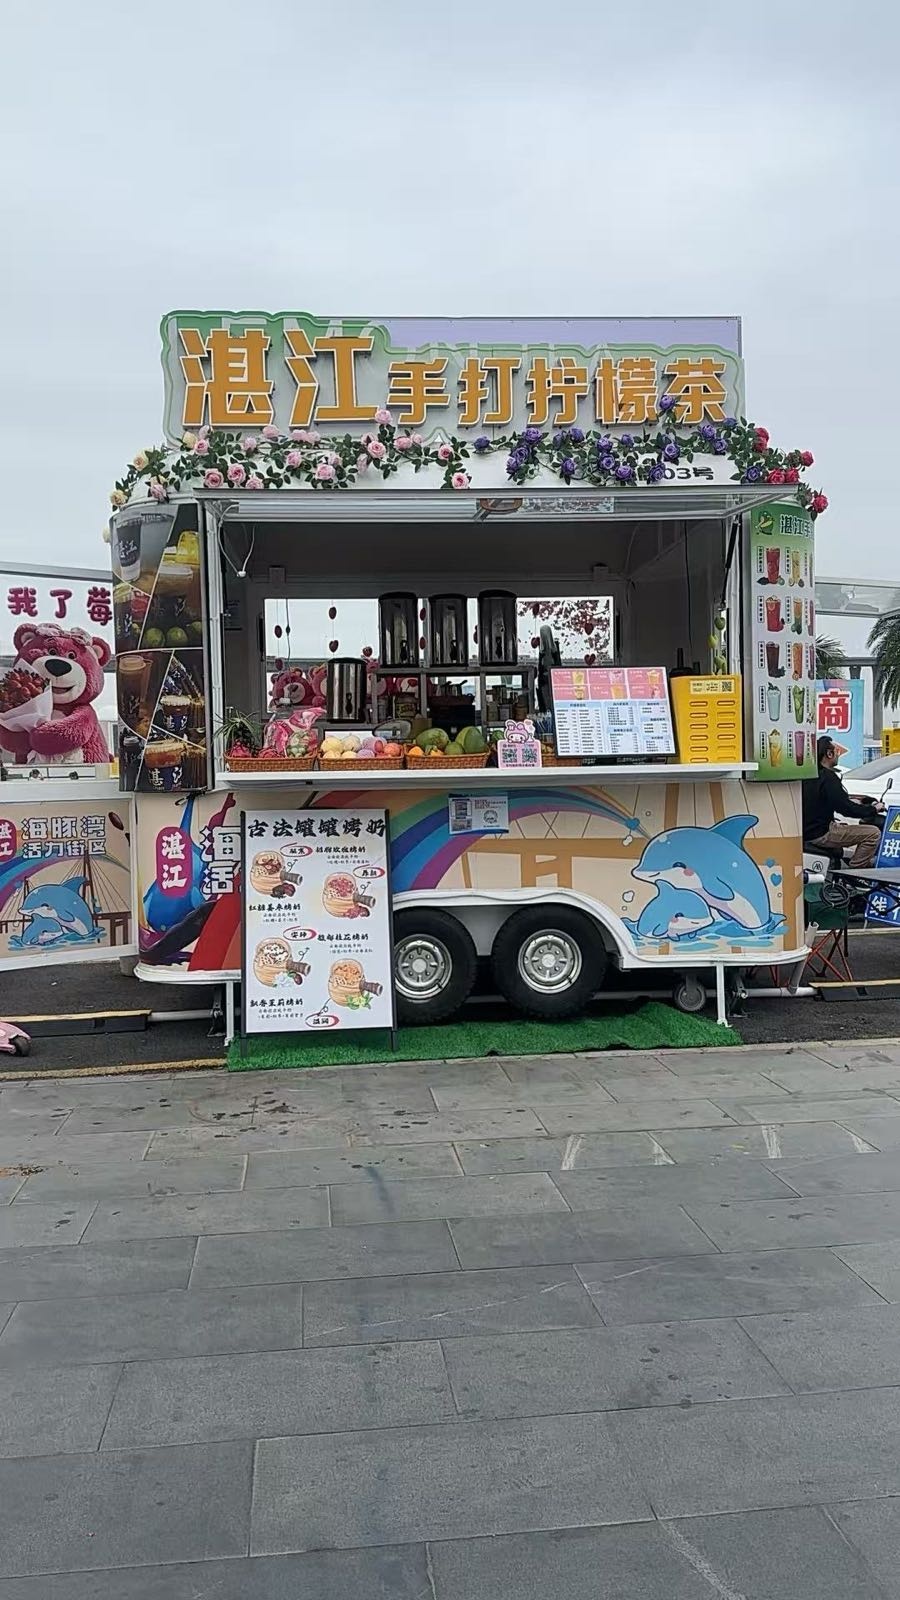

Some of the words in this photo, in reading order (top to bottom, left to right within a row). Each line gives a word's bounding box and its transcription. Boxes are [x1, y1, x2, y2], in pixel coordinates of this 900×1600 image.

[780, 513, 814, 539] 湛江手
[8, 586, 112, 626] 我了莓
[818, 690, 852, 731] 商
[21, 815, 106, 840] 海豚湾
[247, 817, 386, 838] 古法罐罐烤奶
[22, 839, 107, 860] 活力街区
[162, 831, 187, 890] 湛江
